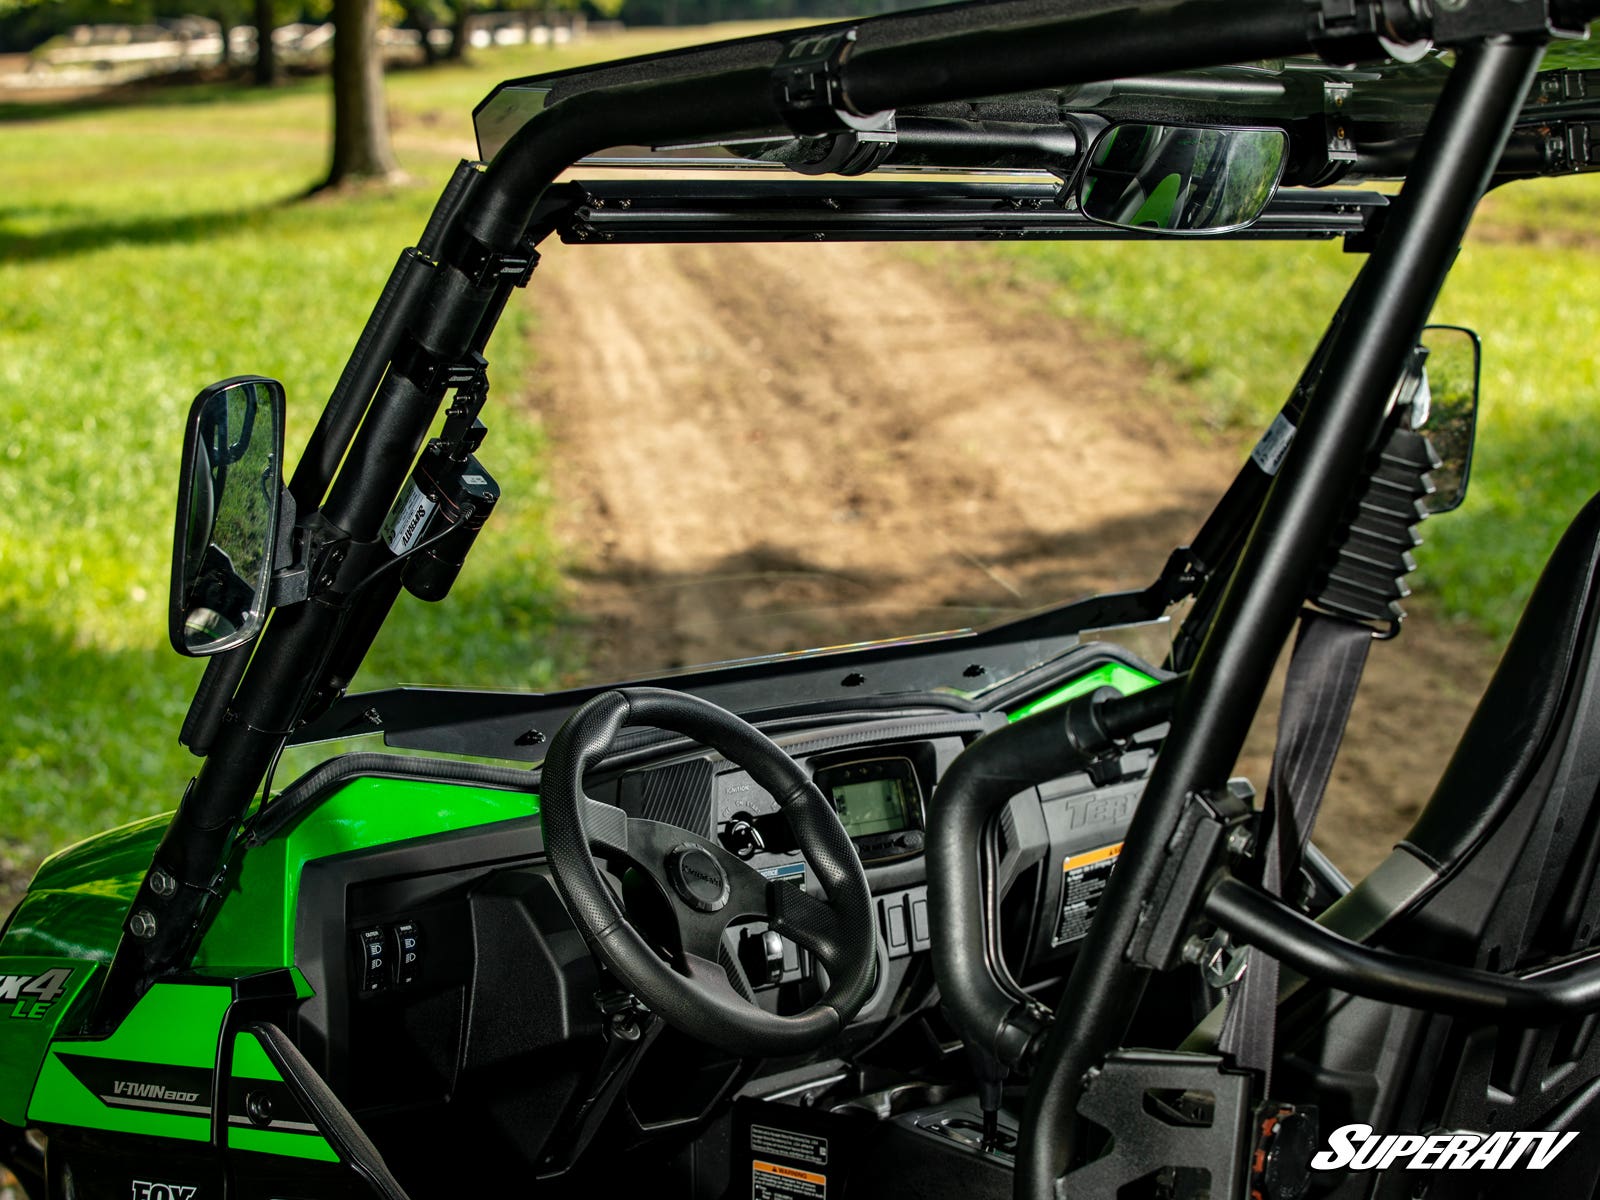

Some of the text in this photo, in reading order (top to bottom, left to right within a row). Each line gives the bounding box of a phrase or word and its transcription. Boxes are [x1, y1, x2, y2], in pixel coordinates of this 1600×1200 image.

[0, 968, 72, 1001] X4
[11, 1000, 52, 1019] LE
[778, 1167, 808, 1179] WARNING
